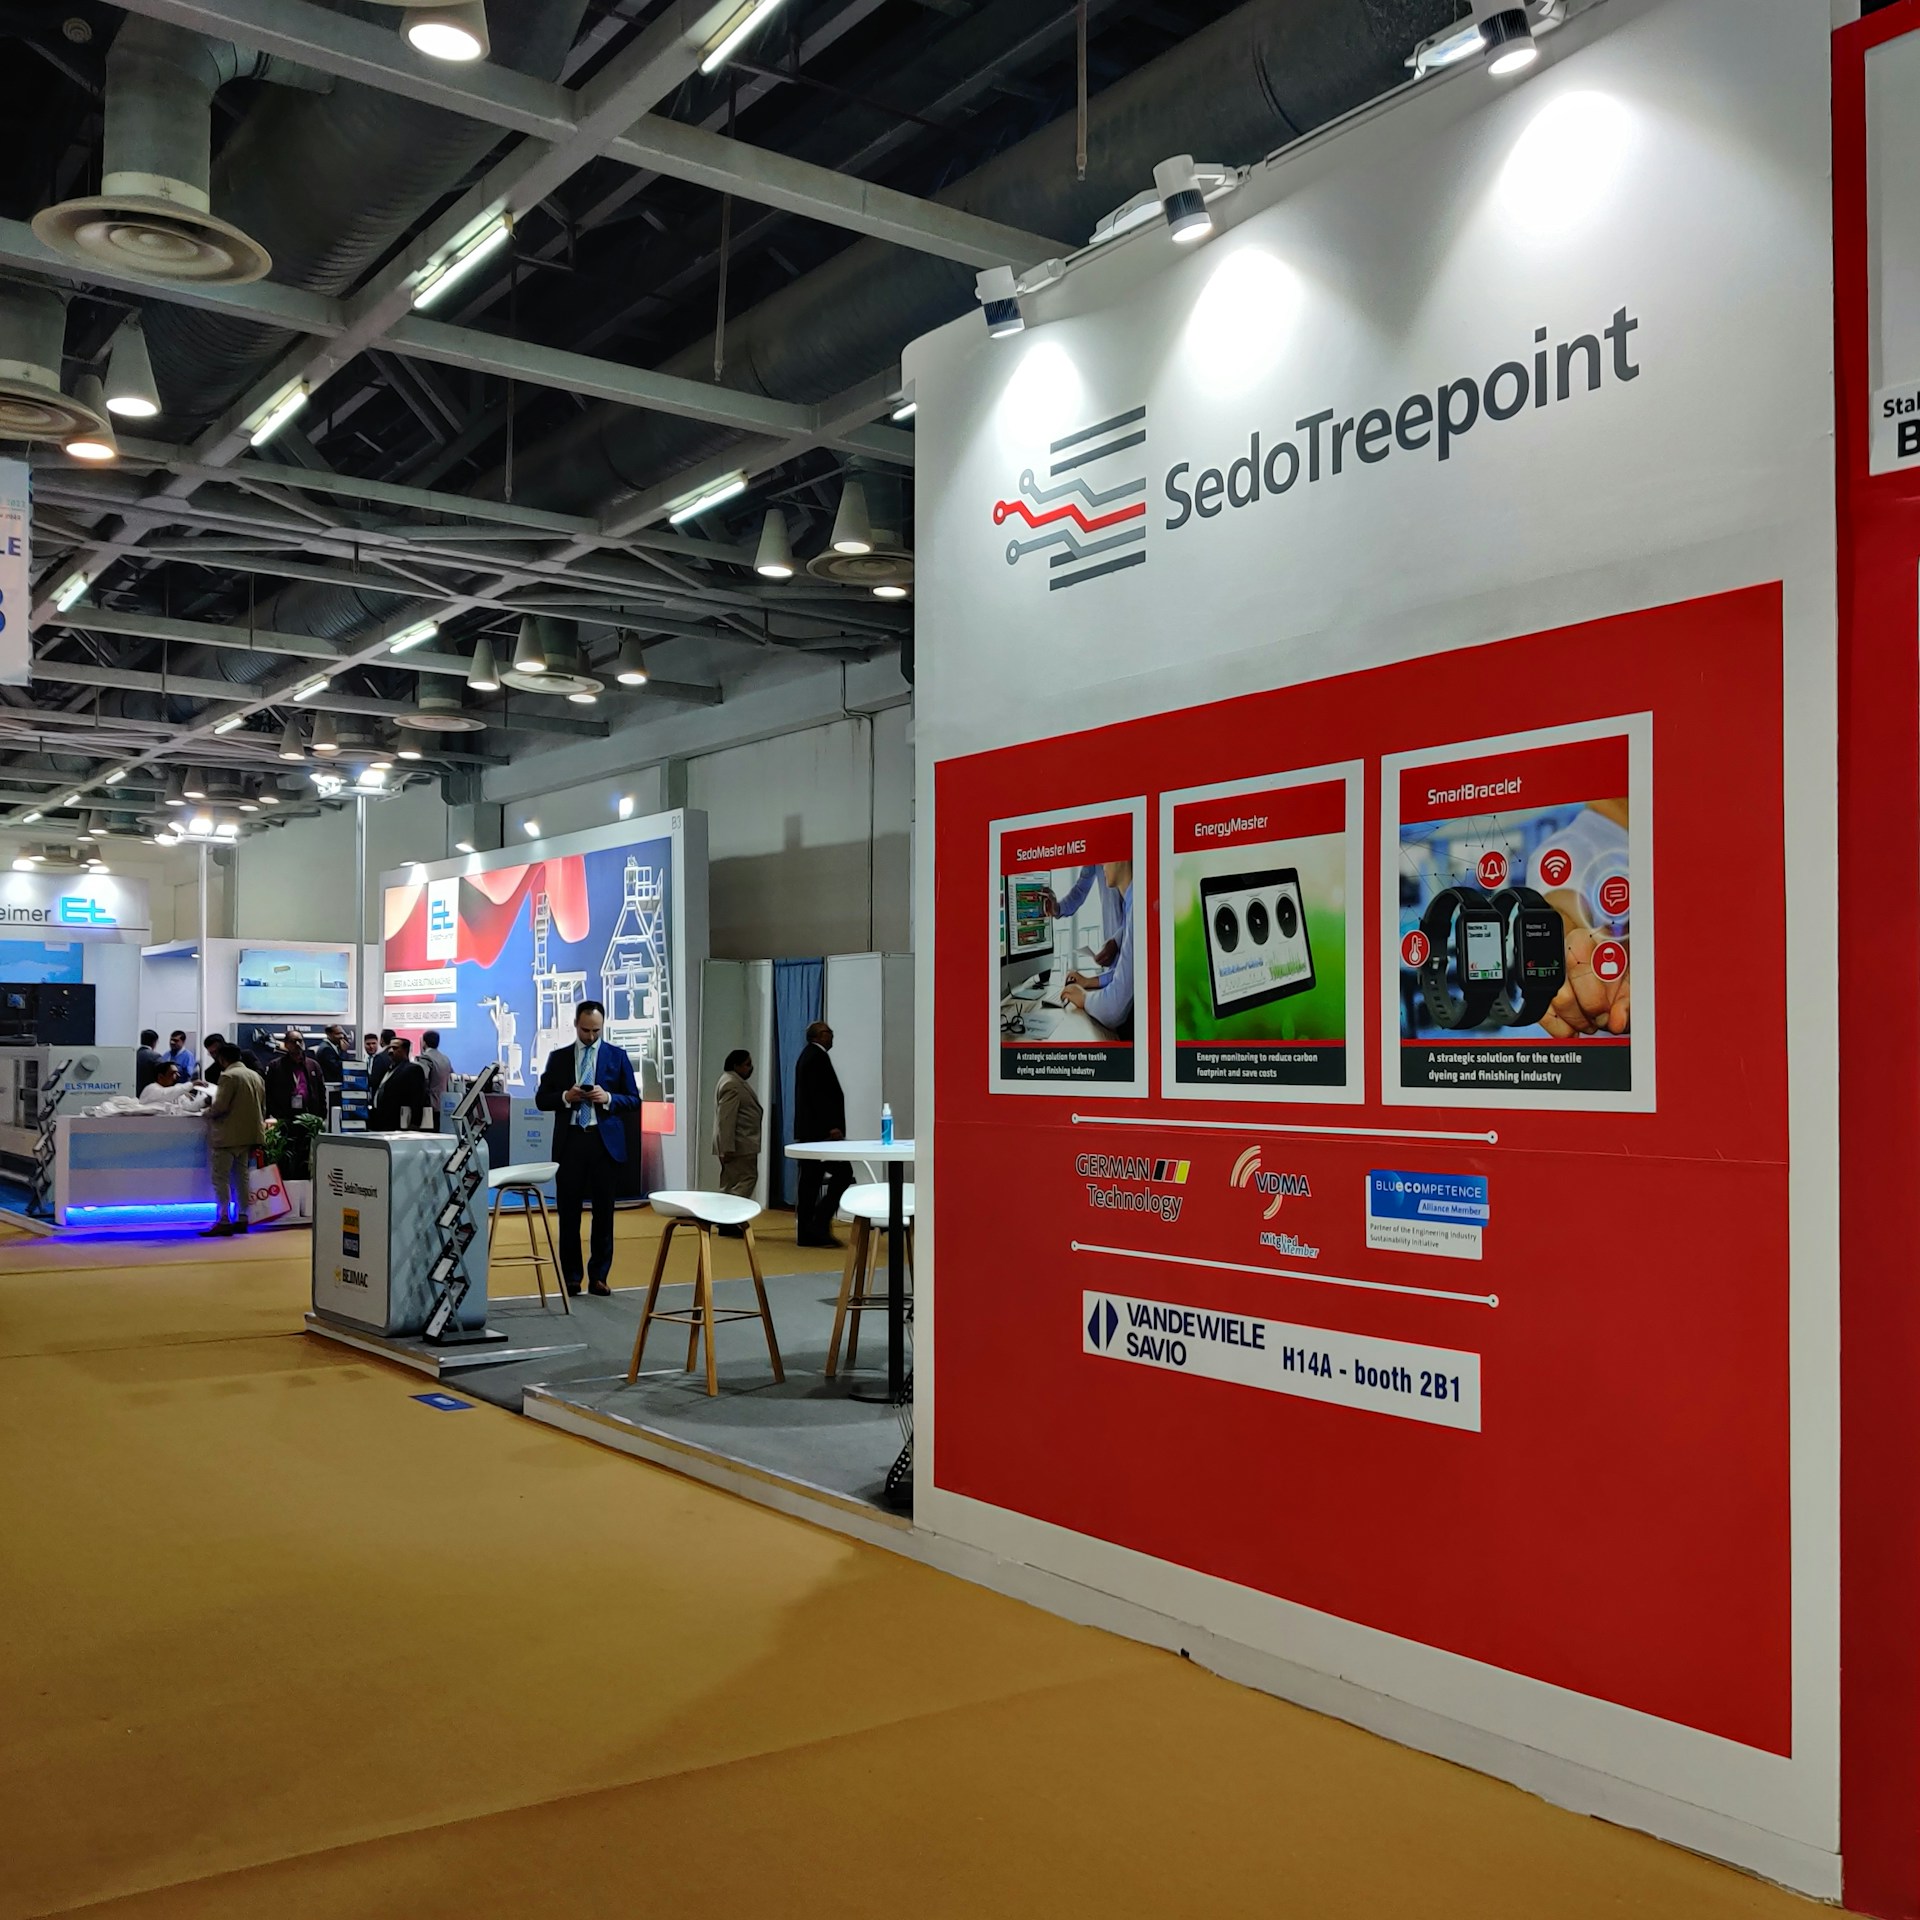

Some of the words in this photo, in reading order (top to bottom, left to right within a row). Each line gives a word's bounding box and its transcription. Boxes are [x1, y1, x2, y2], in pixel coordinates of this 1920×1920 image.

[1165, 305, 1640, 530] SedoTreepoint
[1428, 777, 1522, 805] SmartBracelet
[1195, 815, 1268, 837] EnergyMaster
[1016, 844, 1065, 861] SedoMaster
[1066, 840, 1086, 855] MES
[1017, 1052, 1021, 1061] A
[1022, 1052, 1045, 1063] strategic
[1045, 1052, 1068, 1061] solution
[1069, 1052, 1077, 1061] for
[1078, 1052, 1087, 1061] the
[1088, 1052, 1107, 1062] textile
[1197, 1052, 1220, 1063] Energy
[1220, 1052, 1259, 1064] monitoring
[1259, 1053, 1266, 1062] to
[1268, 1052, 1292, 1062] reduce
[1293, 1052, 1318, 1062] carbon
[1428, 1052, 1435, 1062] A
[1436, 1052, 1475, 1065] strategic
[1476, 1052, 1515, 1063] solution
[1516, 1052, 1531, 1063] for
[1532, 1052, 1548, 1063] the
[1550, 1052, 1582, 1063] textile
[1017, 1065, 1035, 1076] dyeing
[1035, 1066, 1046, 1075] and
[1046, 1066, 1071, 1077] finishing
[1071, 1066, 1096, 1077] industry
[1197, 1067, 1227, 1078] footprint
[1227, 1068, 1241, 1077] and
[1242, 1069, 1258, 1077] save
[1258, 1069, 1277, 1078] costs
[1428, 1069, 1458, 1083] dyeing
[1459, 1070, 1476, 1081] and
[1478, 1070, 1520, 1084] finishing
[1521, 1070, 1562, 1084] industry
[64, 1082, 122, 1090] ELSTRAIGHT
[1075, 1153, 1150, 1181] GERMAN
[1255, 1171, 1312, 1197] VDMA
[1086, 1183, 1183, 1222] Technology
[1422, 1203, 1450, 1213] Alliance
[1451, 1205, 1481, 1216] Member
[1370, 1223, 1392, 1232] Partner
[1412, 1227, 1449, 1239] Engineering
[1260, 1232, 1298, 1250] Mitglied
[1370, 1234, 1411, 1246] Sustainability
[1280, 1244, 1320, 1259] Member
[1127, 1302, 1266, 1350] VANDEWIELE
[1126, 1333, 1187, 1366] SAVIO
[1282, 1346, 1333, 1379] H14A
[1355, 1359, 1412, 1394] booth
[1420, 1371, 1461, 1403] 2B1
